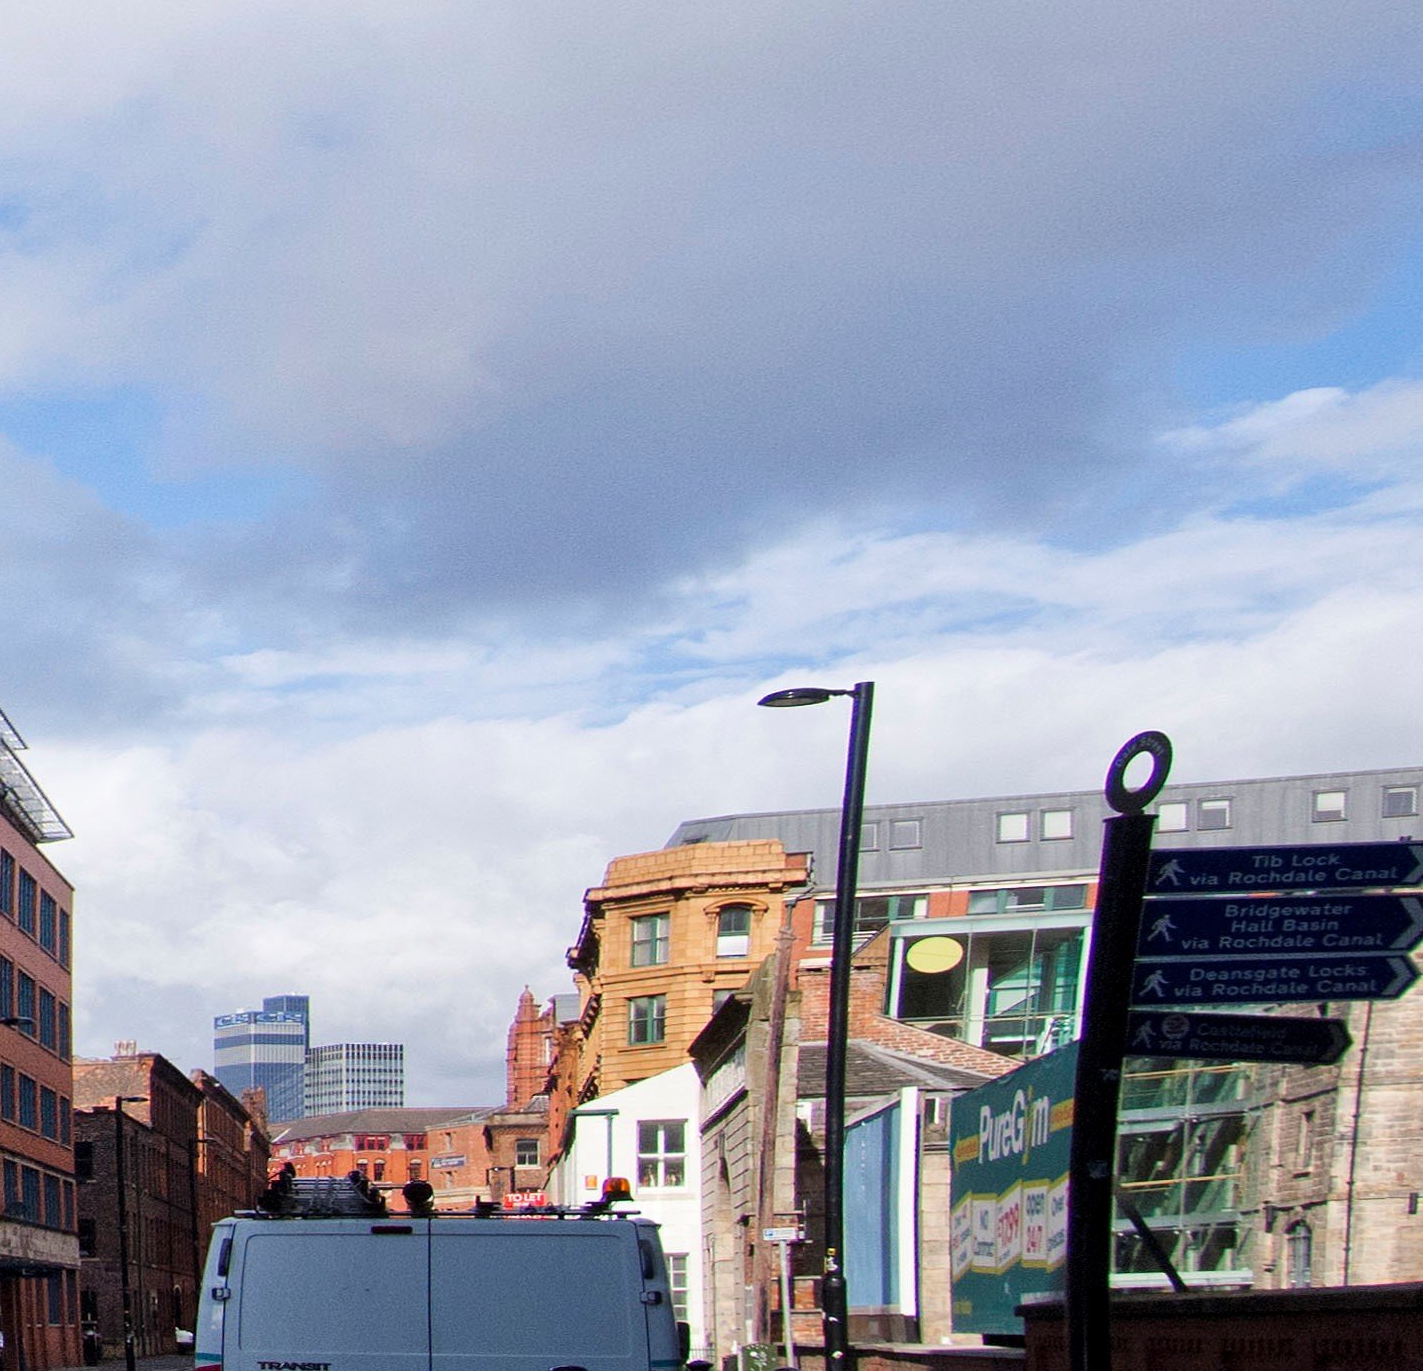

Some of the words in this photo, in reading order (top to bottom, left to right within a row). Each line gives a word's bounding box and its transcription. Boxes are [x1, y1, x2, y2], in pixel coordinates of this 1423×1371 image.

[1253, 855, 1283, 868] Tib
[1291, 853, 1340, 867] Lock
[1190, 873, 1219, 886] via
[1228, 870, 1327, 884] Rochdale
[1335, 867, 1398, 880] Canal
[1225, 903, 1353, 921] Bridgewater
[1231, 920, 1273, 932] Hall
[1283, 919, 1339, 931] Basin
[1181, 938, 1209, 950] via
[1219, 935, 1315, 949] Rochdale
[1322, 933, 1384, 947] Canal
[1190, 967, 1301, 982] Deansgate
[1309, 964, 1369, 977] Locks
[1174, 985, 1203, 997] via
[1212, 982, 1308, 996] Rochdale
[1316, 979, 1376, 993] Canal
[1159, 1040, 1182, 1050] via
[1189, 1039, 1264, 1053] Rochdale
[979, 1085, 1050, 1165] PureGym
[506, 1193, 522, 1202] TO
[524, 1192, 542, 1202] LET
[257, 1361, 332, 1371] TRANSIT
